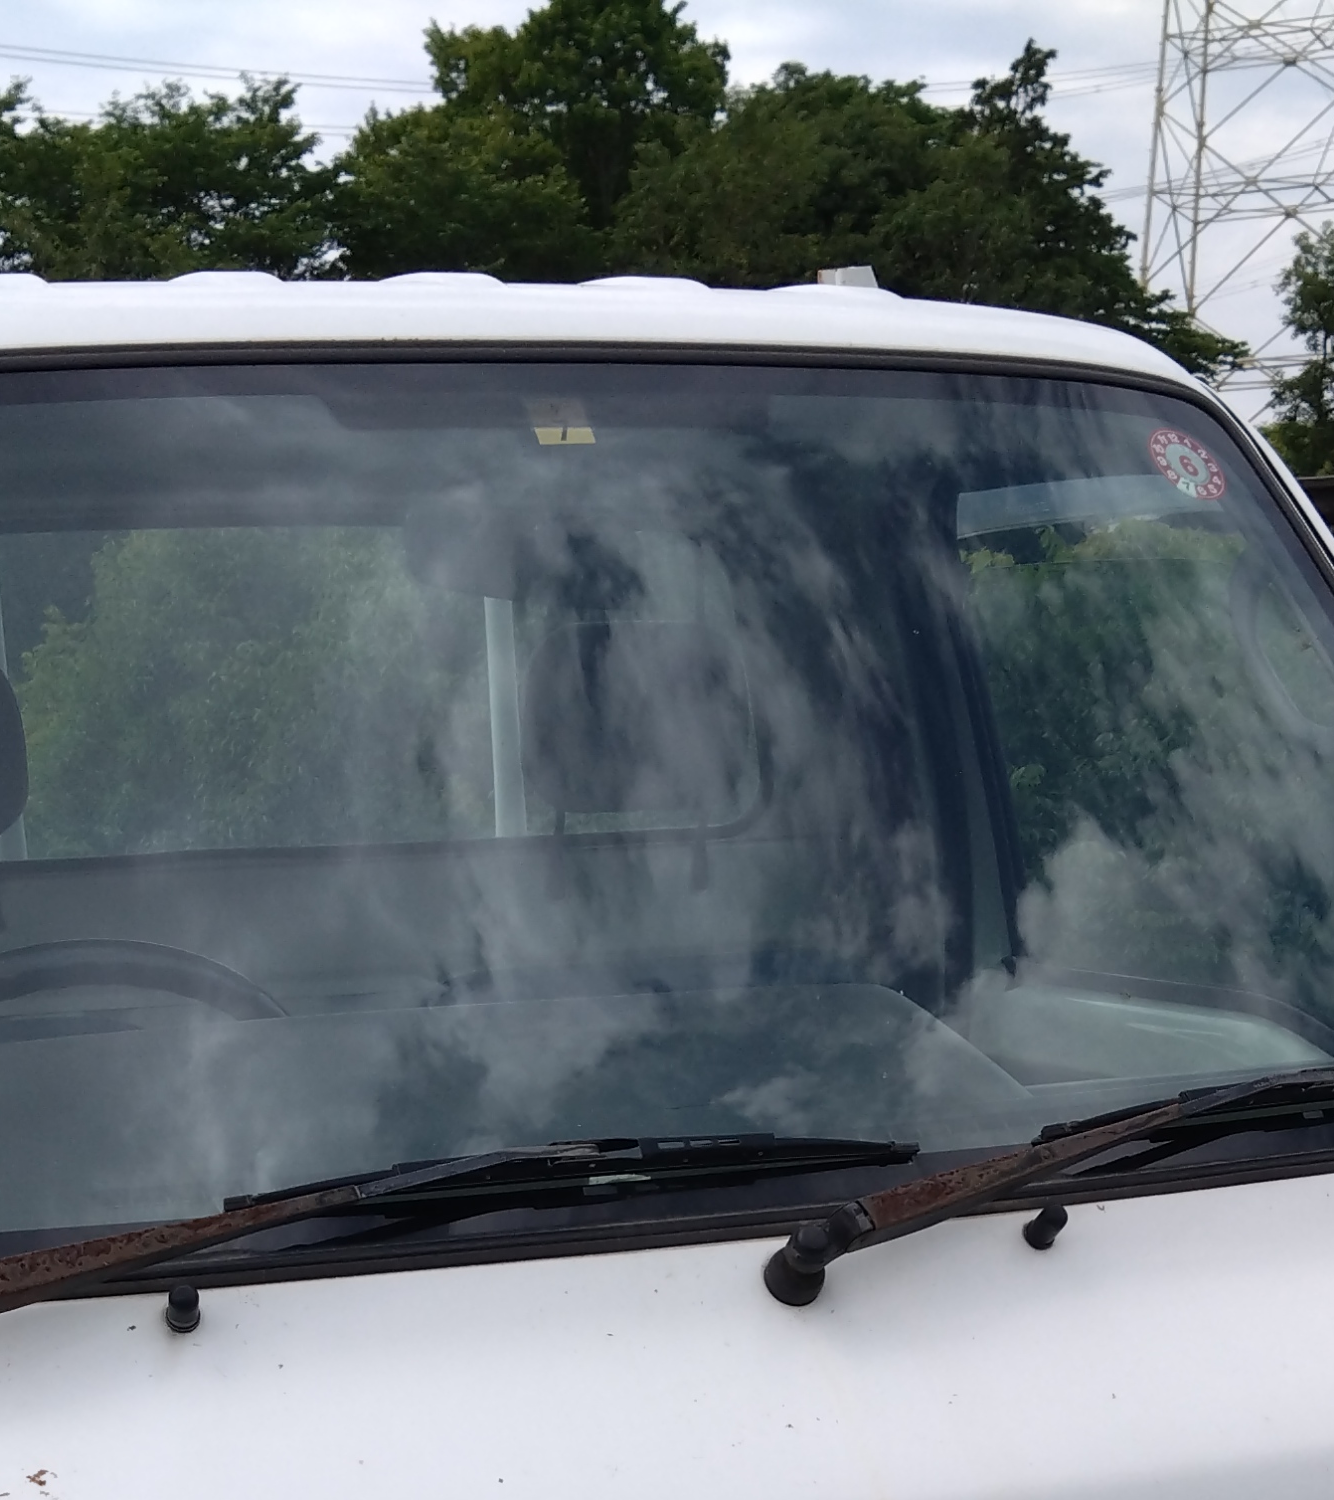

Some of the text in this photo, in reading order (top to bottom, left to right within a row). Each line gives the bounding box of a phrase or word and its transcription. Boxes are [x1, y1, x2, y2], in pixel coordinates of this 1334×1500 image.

[1197, 449, 1208, 459] 2
[1207, 463, 1218, 472] 3
[1212, 476, 1222, 485] 4
[1181, 481, 1190, 491] 7
